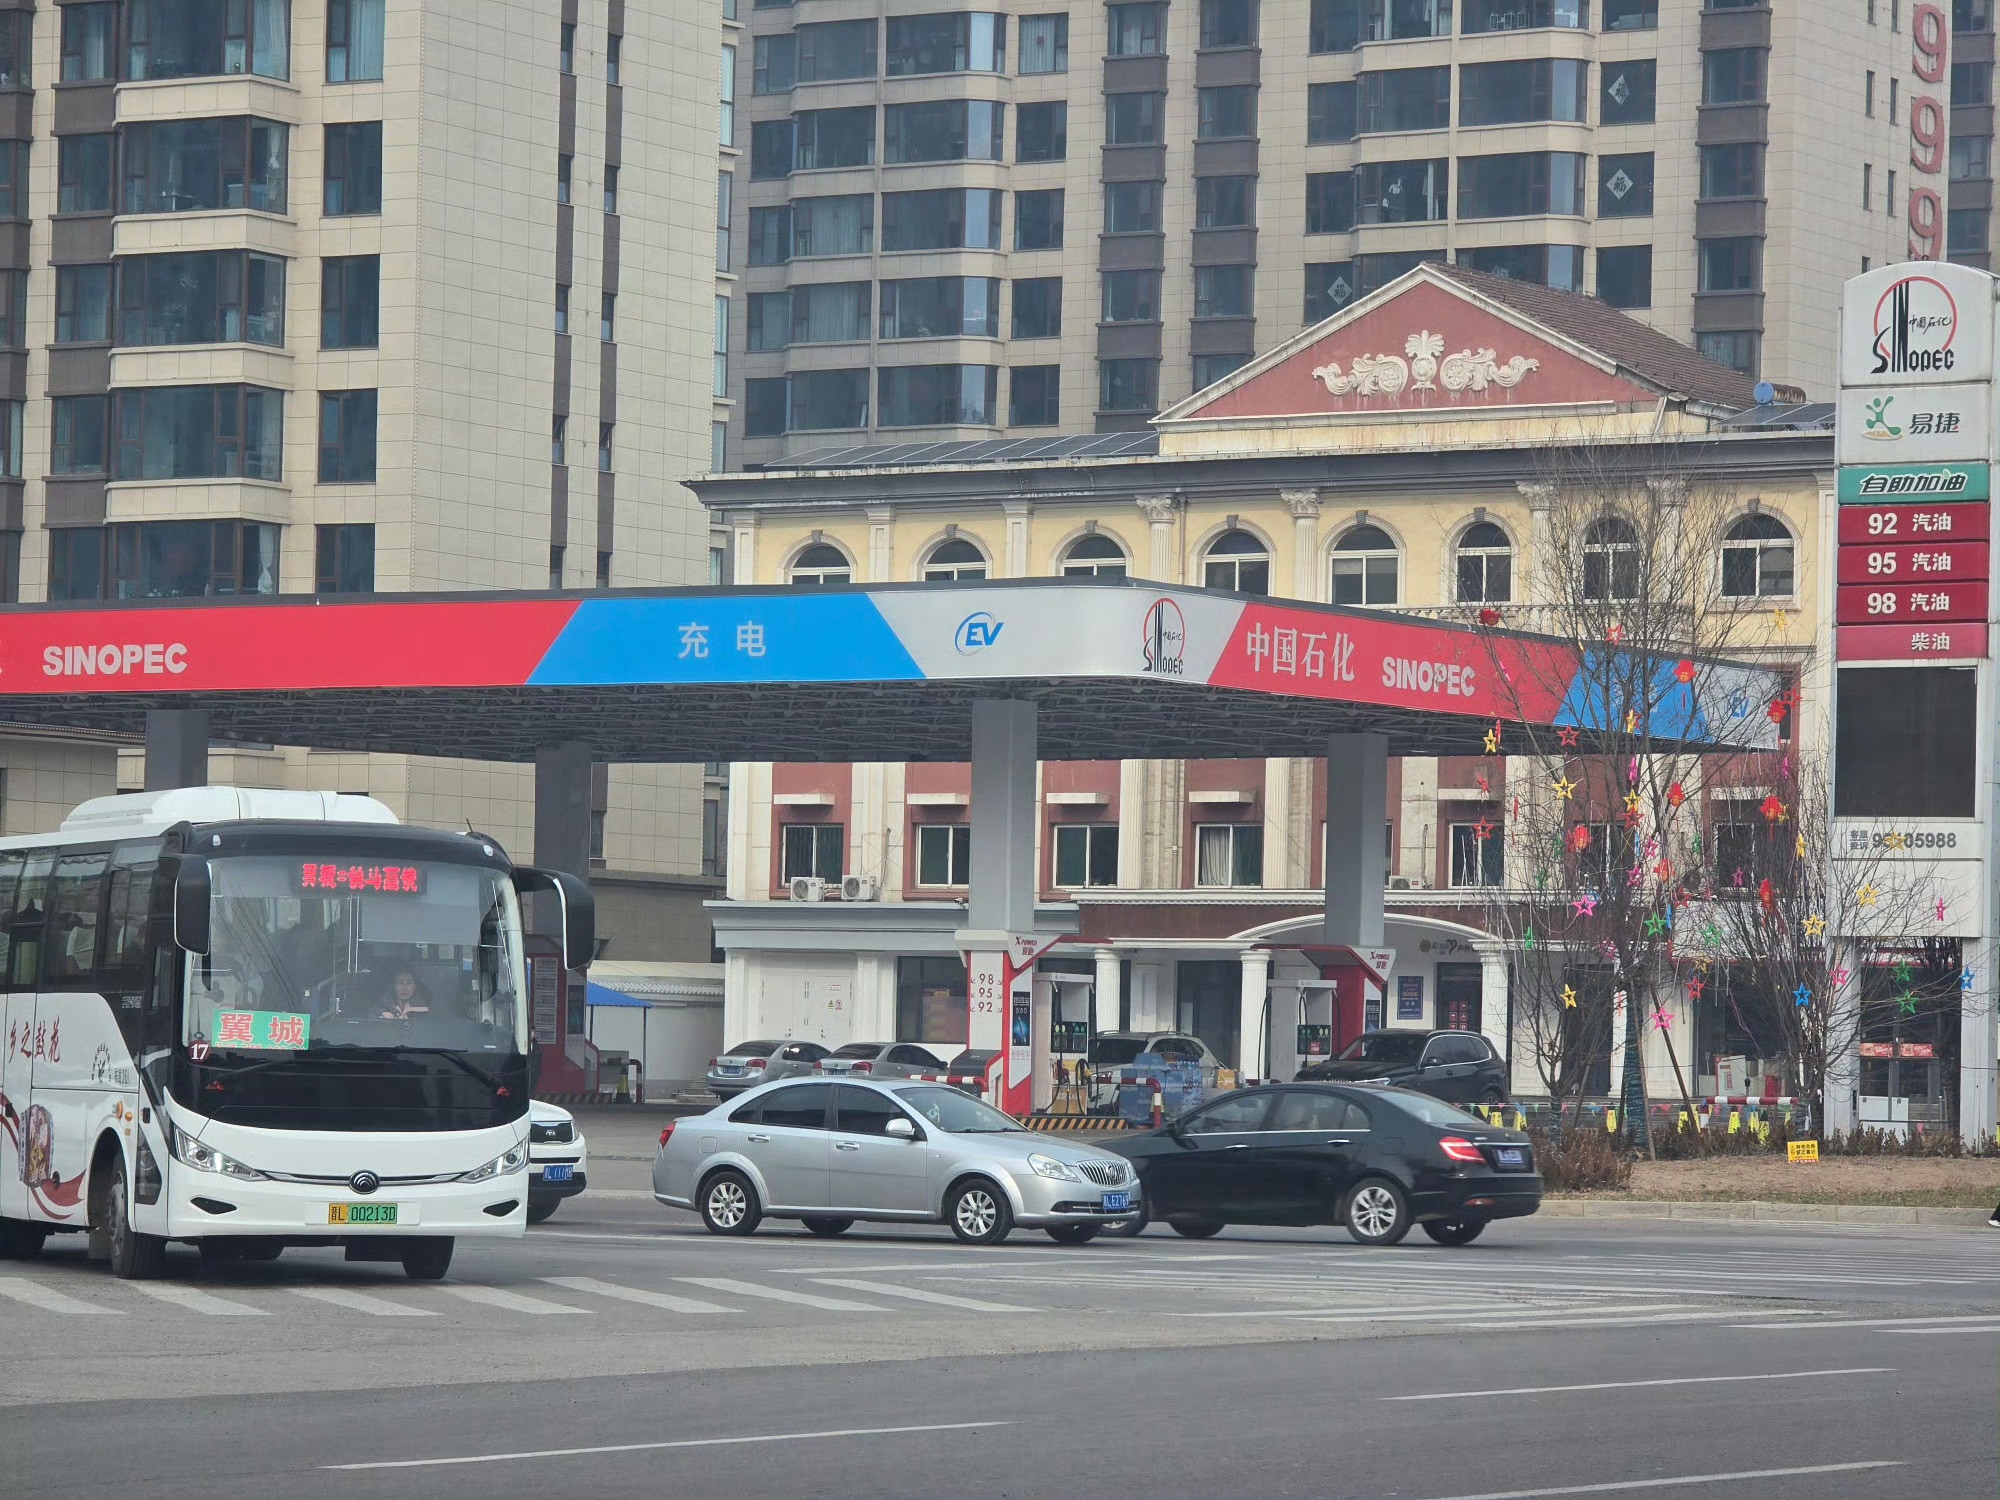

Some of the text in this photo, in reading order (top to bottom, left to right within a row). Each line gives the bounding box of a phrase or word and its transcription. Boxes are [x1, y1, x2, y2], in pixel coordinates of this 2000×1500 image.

[1871, 281, 1954, 374] SINOPEC
[1909, 314, 1952, 335] 中国石化
[1909, 412, 1961, 434] 易捷
[1861, 474, 1967, 493] 自助加油
[1868, 512, 1952, 535] 92 汽油
[1867, 552, 1952, 574] 95 汽油
[1867, 592, 1950, 614] 98 汽油
[677, 620, 767, 659] 充电
[965, 621, 1004, 647] EV
[1911, 632, 1950, 651] 柴油
[42, 643, 188, 676] SINOPEC
[1246, 622, 1355, 682] 中国石化
[1382, 655, 1475, 698] SINOPEC
[1872, 832, 1957, 849] 9505988
[979, 973, 994, 985] 98
[978, 988, 993, 998] 95
[978, 1002, 993, 1013] 92
[219, 1013, 304, 1046] 翼城
[190, 1044, 209, 1060] 17
